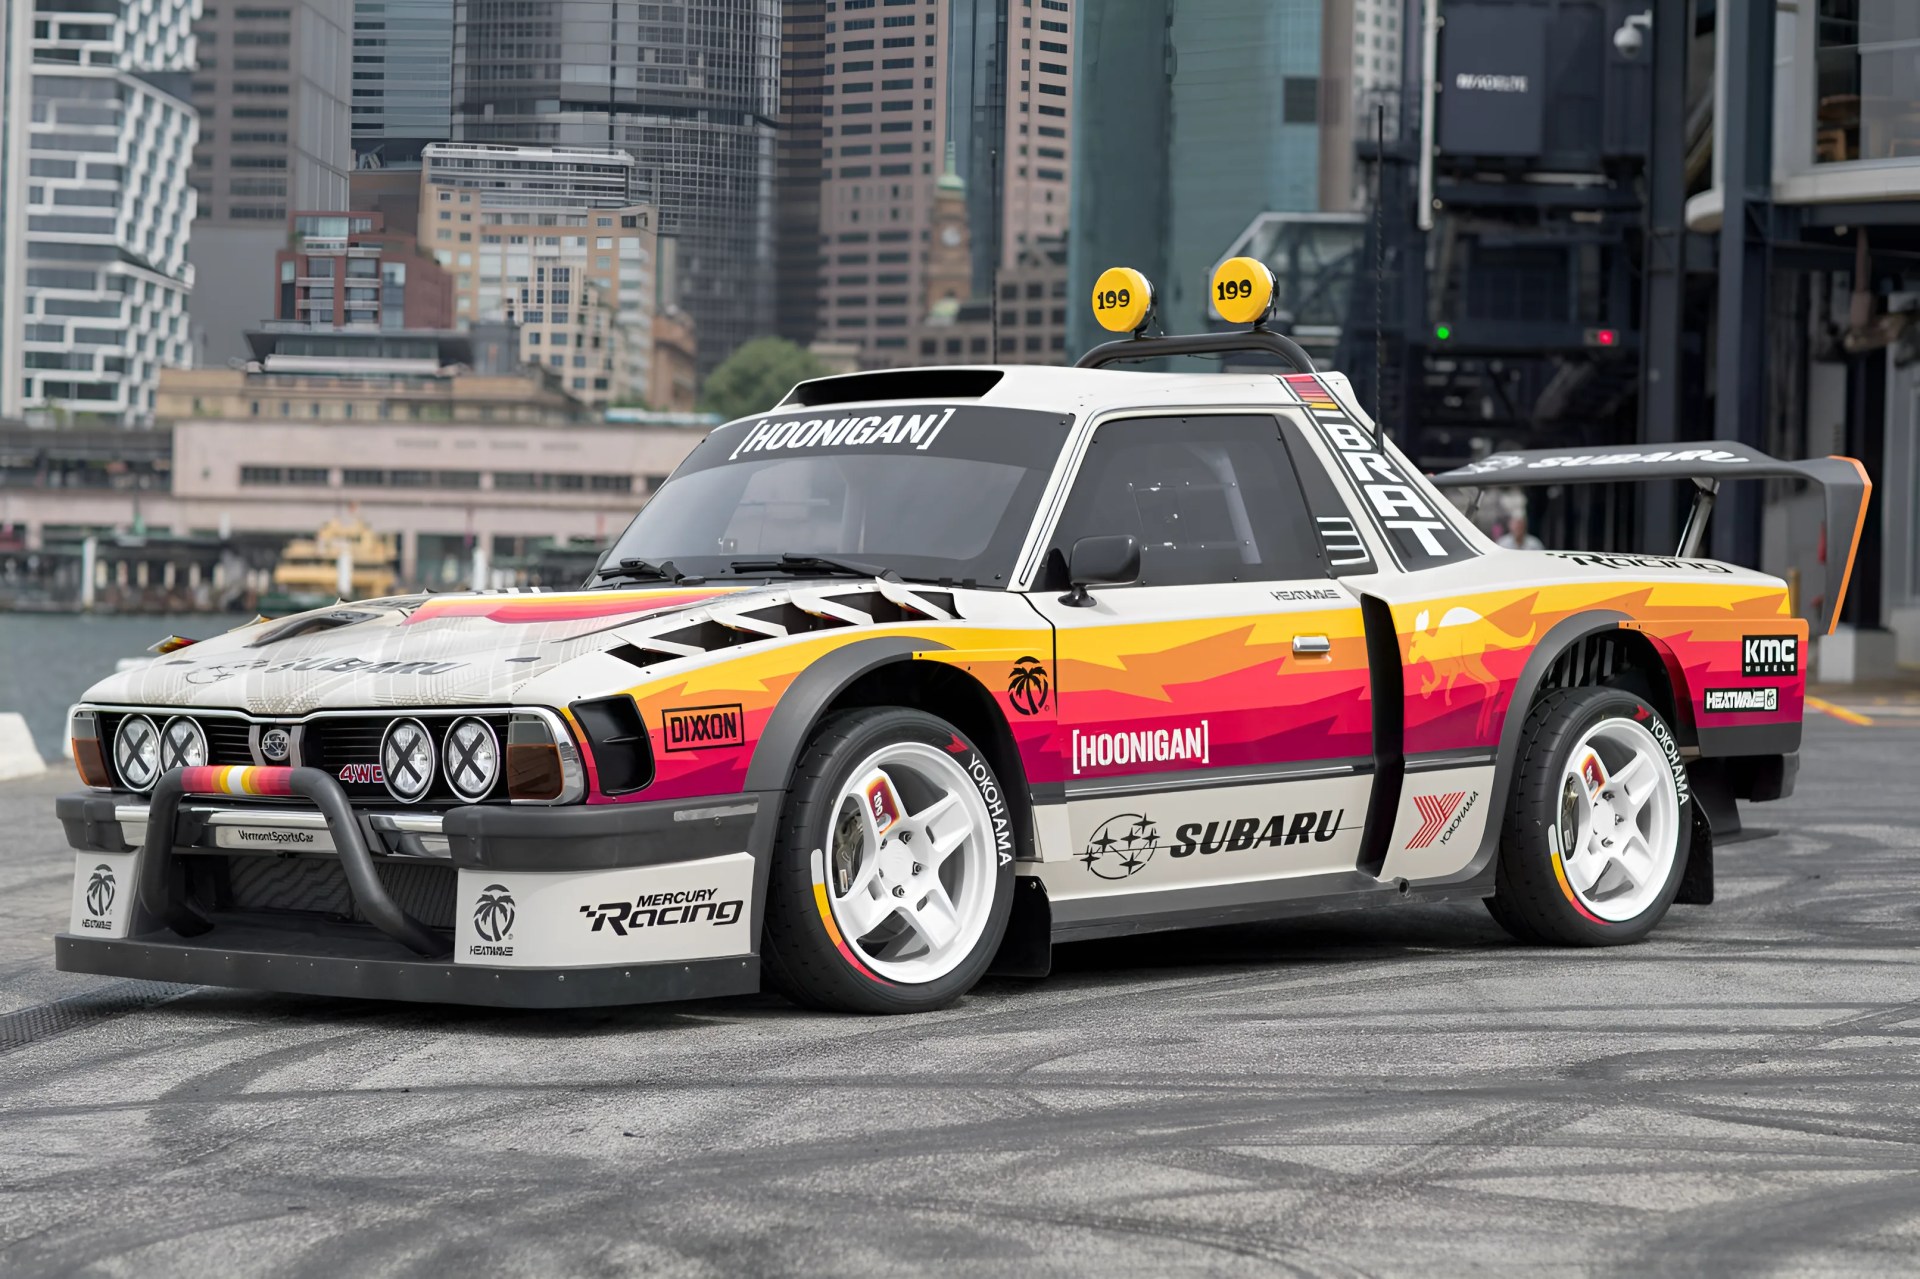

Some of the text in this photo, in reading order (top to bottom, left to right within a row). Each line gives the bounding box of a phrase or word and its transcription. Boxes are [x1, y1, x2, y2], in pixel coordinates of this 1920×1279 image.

[1098, 289, 1130, 310] 199
[1217, 279, 1252, 300] 199
[728, 408, 956, 460] [HOONIGAN]
[1527, 449, 1749, 468] SUBARU
[1322, 423, 1449, 556] BRAT
[1563, 553, 1733, 574] Racing
[1269, 589, 1341, 601] HEATWAVE
[670, 712, 737, 743] DIXXON
[1072, 720, 1210, 775] [HOONIGAN]
[1650, 715, 1690, 806] YOKOHAMA
[968, 753, 1013, 867] YOKOHAMA
[238, 829, 314, 843] VermontSportsCar
[1169, 808, 1345, 858] SUBARU
[636, 888, 718, 907] MERCURY
[591, 899, 744, 936] Racing
[469, 945, 514, 957] HEATWAVE
